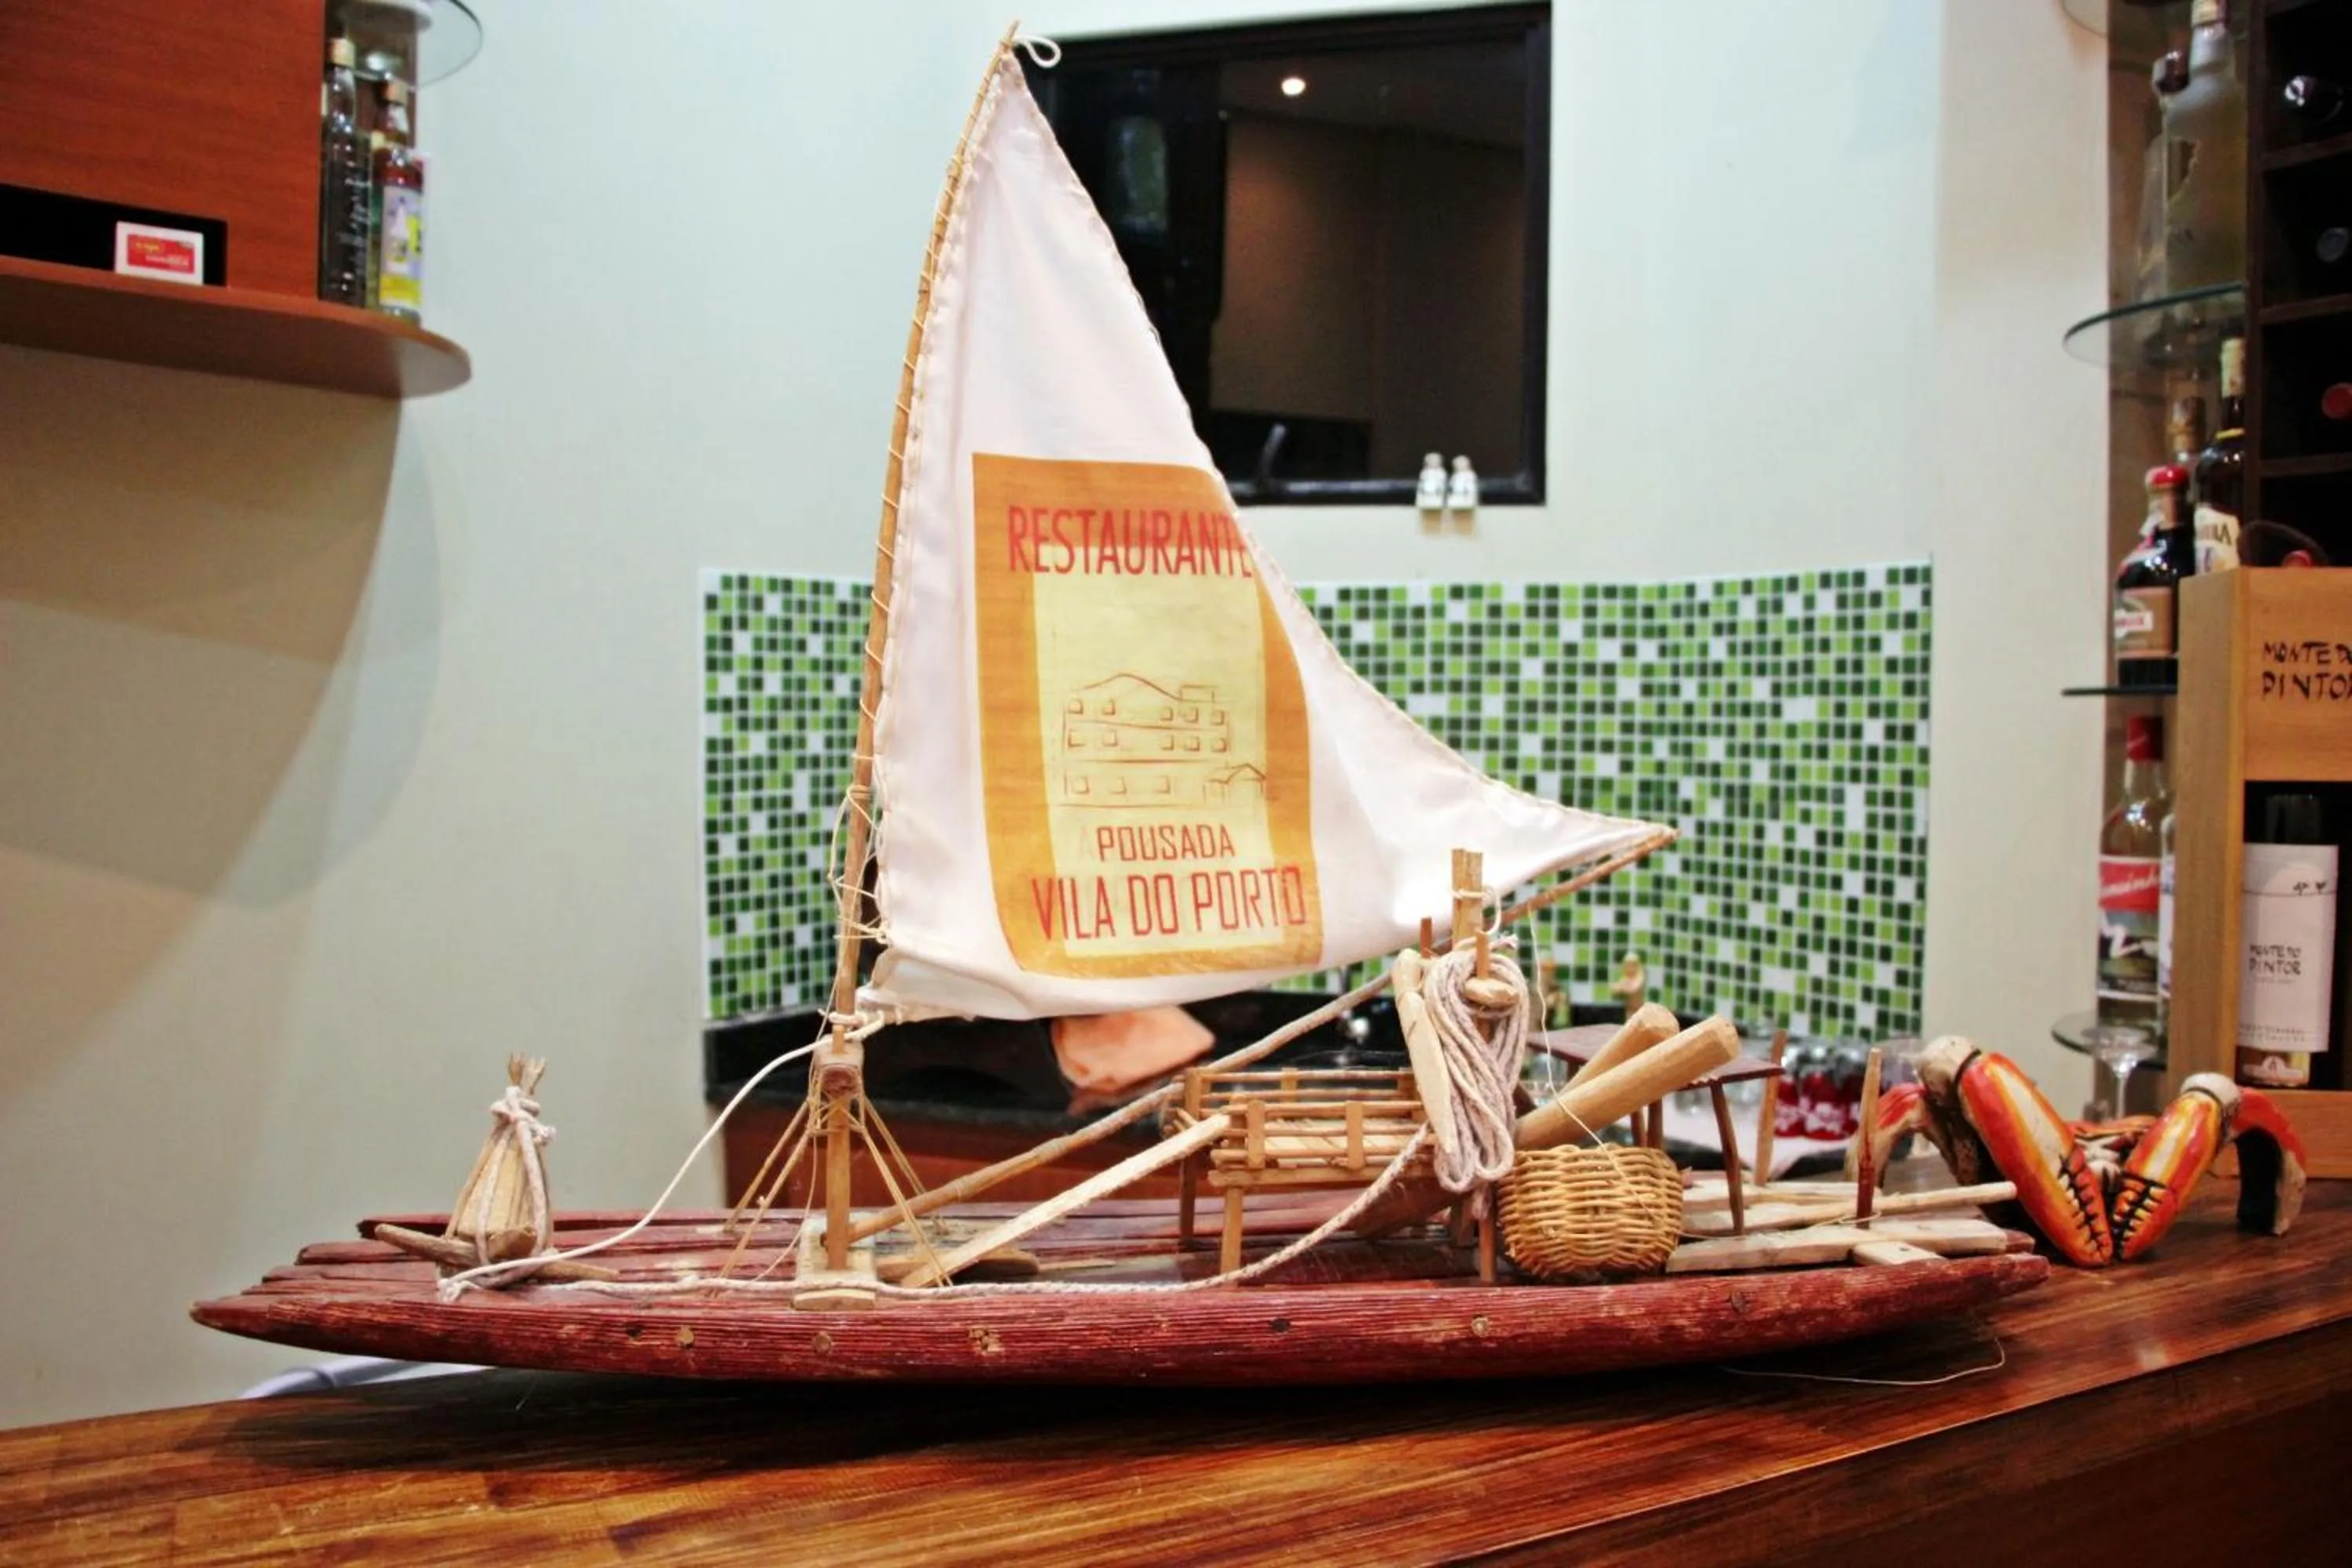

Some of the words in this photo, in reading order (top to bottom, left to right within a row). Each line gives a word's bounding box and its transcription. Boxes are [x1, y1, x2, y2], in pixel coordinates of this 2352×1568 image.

[1007, 506, 1252, 578] RESTAURANTE
[2263, 641, 2331, 665] MONTE
[1096, 823, 1236, 862] POUSADA
[1031, 875, 1116, 941] VILA
[1127, 873, 1179, 936] DO
[1190, 865, 1306, 931] PORTO
[2249, 957, 2301, 975] PINTOR
